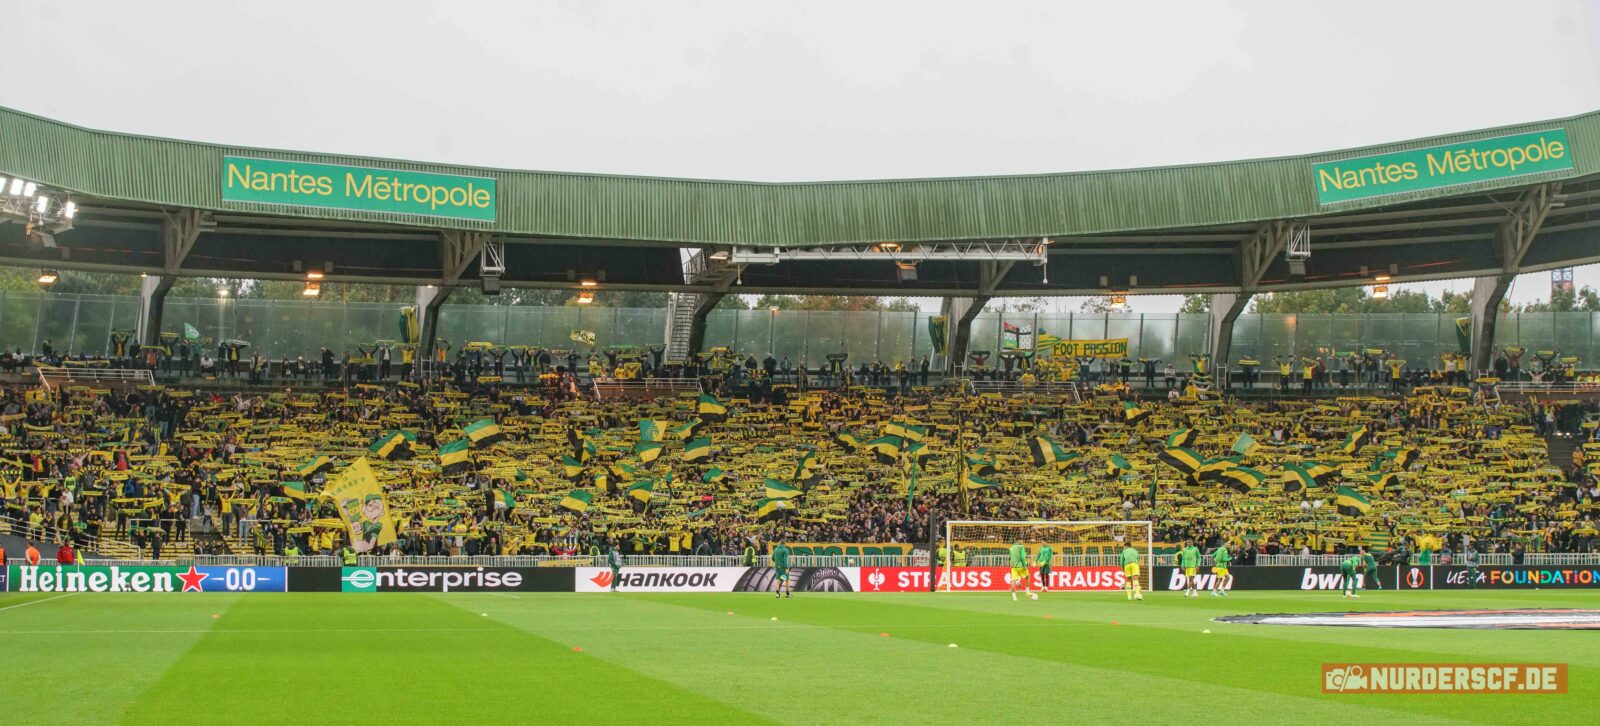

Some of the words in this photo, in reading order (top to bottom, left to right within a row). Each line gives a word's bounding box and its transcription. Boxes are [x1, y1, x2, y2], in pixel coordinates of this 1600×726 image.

[228, 163, 333, 196] Nantes
[1319, 161, 1419, 192] Nantes
[1053, 342, 1079, 356] FOOT
[1084, 341, 1128, 355] PASSION
[19, 565, 174, 592] Heineken
[350, 566, 523, 593] enterprise
[1033, 571, 1126, 588] STRAUSS
[1446, 571, 1487, 585] UEA
